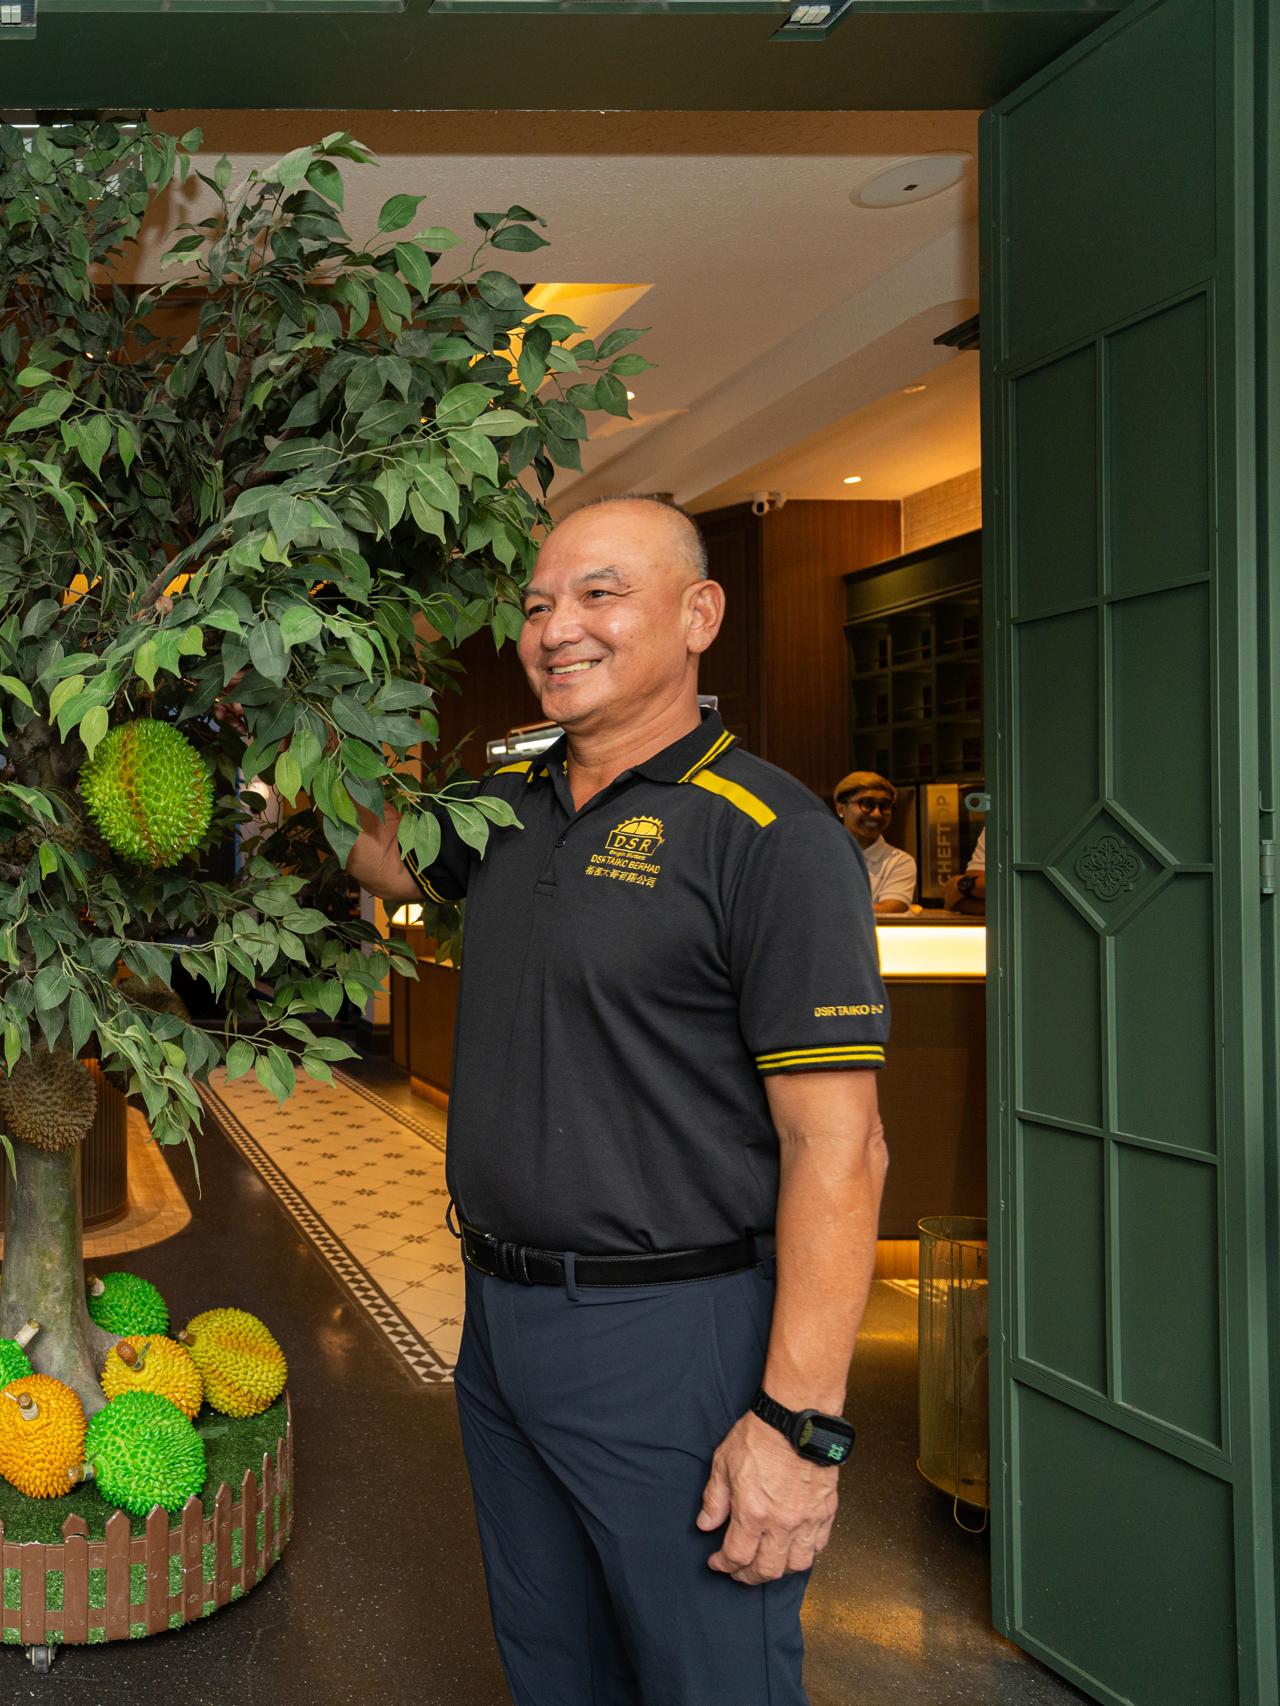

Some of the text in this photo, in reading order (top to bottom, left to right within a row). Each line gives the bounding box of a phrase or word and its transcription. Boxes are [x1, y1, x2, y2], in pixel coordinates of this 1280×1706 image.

[614, 836, 652, 852] DSR
[606, 857, 628, 868] TAIKO
[628, 861, 660, 874] BERHAD
[814, 1006, 837, 1017] DSR
[838, 1005, 870, 1016] TAIKO
